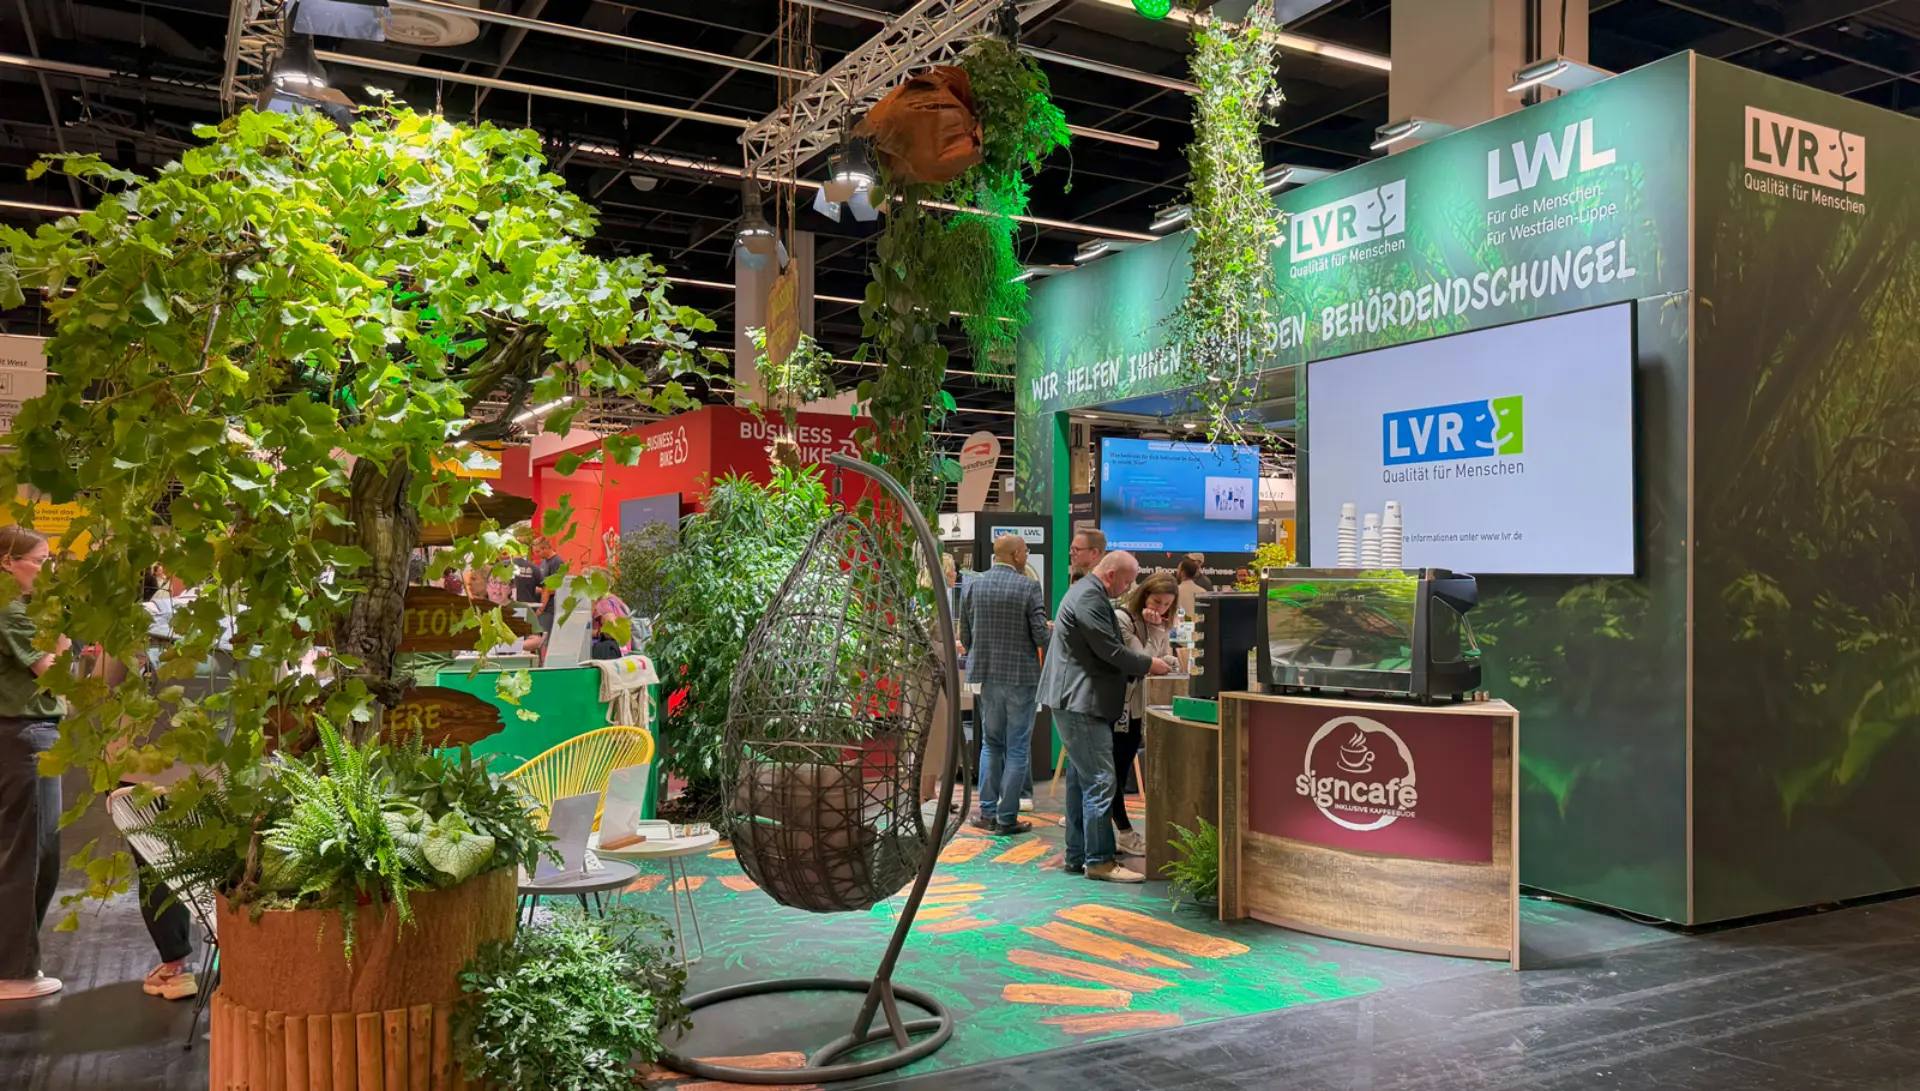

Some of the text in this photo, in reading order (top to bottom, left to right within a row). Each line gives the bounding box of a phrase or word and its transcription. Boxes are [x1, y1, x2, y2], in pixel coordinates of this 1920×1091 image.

[1488, 118, 1616, 200] LWL
[1752, 117, 1820, 176] LVR
[1487, 184, 1604, 226] Für die Menschen.
[1744, 173, 1866, 215] Qualität für Menschen
[1297, 204, 1357, 255] LVR
[1486, 202, 1619, 247] Für Westfalen-Lippe.
[1290, 238, 1405, 279] Qualität für Menschen
[1031, 371, 1059, 401] WIR
[1066, 357, 1120, 394] HELFEN
[1265, 312, 1307, 351] DEN
[1321, 239, 1637, 342] BEHÖRDENDSCHUNGEL
[647, 430, 674, 452] BUSINESS
[1389, 411, 1465, 458] LVR
[660, 450, 674, 468] BIKE
[799, 446, 833, 465] IKE
[1383, 459, 1525, 484] Qualität für Menschen
[1024, 528, 1042, 537] LWL
[1411, 532, 1458, 543] Informationen
[1460, 532, 1479, 542] unter
[1480, 530, 1523, 541] www.lvr.de
[1334, 803, 1368, 813] INKLUSIVE
